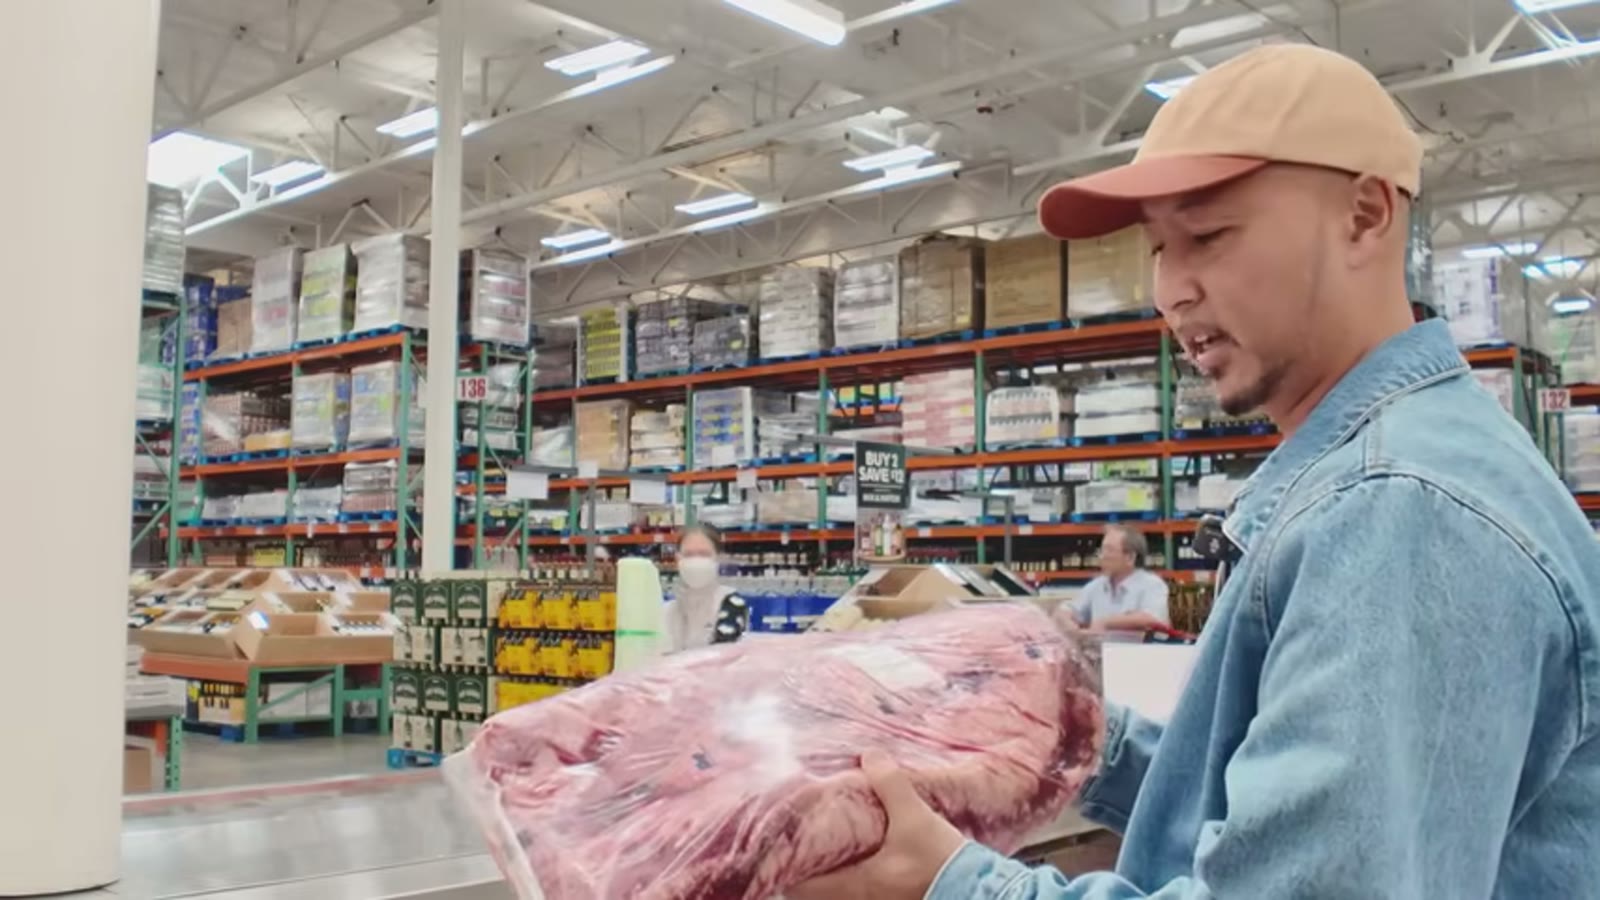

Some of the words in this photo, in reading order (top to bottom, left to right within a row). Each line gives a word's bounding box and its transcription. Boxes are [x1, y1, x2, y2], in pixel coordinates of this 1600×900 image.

[460, 378, 486, 398] 136
[1541, 391, 1567, 408] 132
[865, 450, 890, 466] BUY
[891, 453, 899, 468] 2
[858, 466, 889, 483] SAVE
